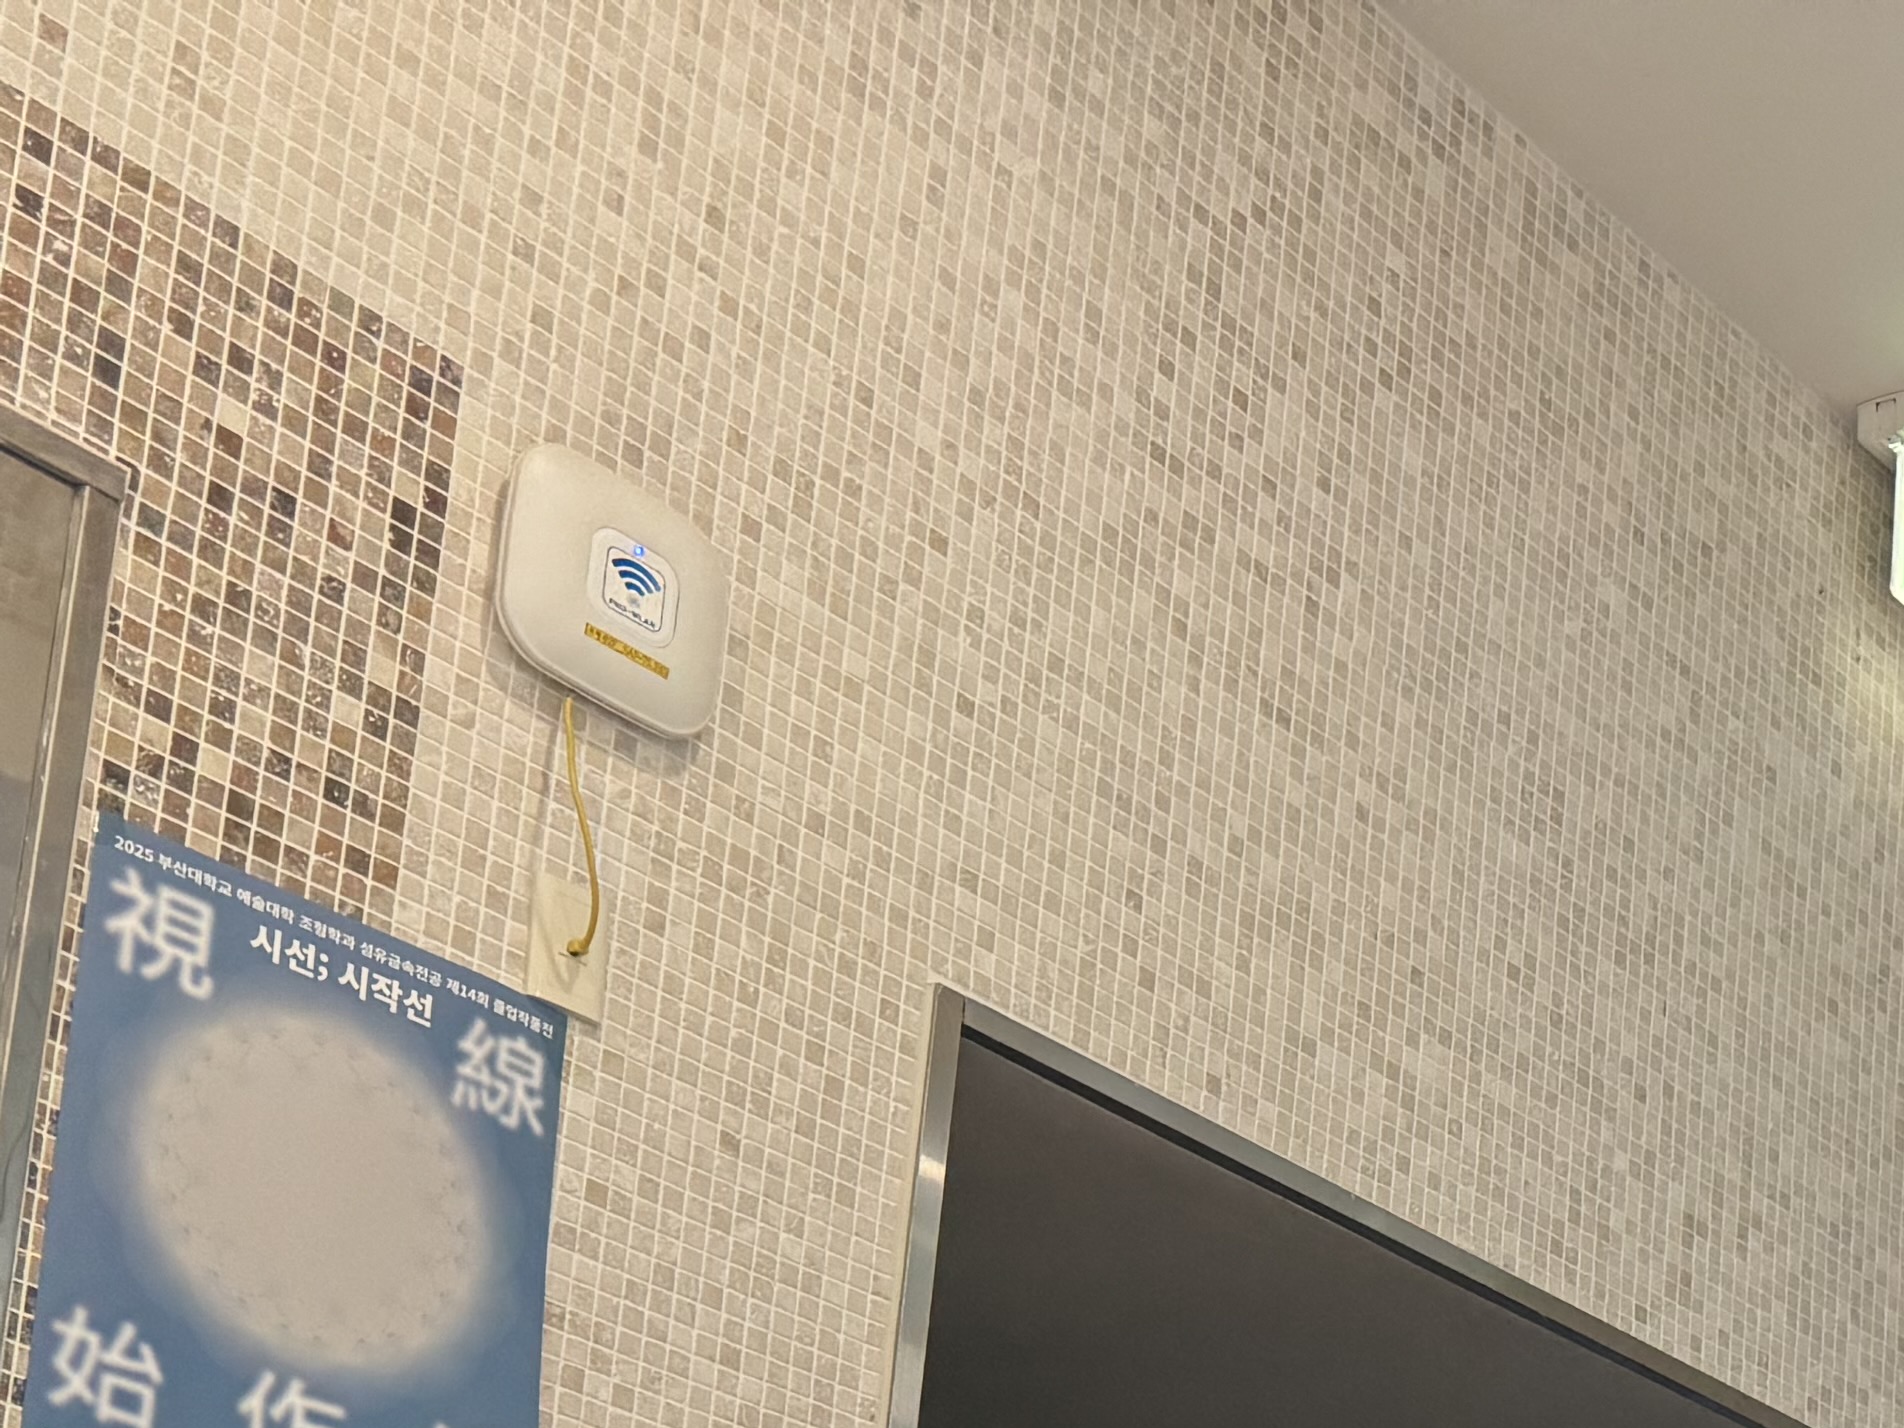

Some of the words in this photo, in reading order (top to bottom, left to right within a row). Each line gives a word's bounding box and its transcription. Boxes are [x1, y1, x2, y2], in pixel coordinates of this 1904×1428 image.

[114, 836, 154, 862] 2025
[158, 853, 232, 897] 부산대학교
[250, 925, 329, 981] 시선;
[338, 962, 433, 1028] 시작선
